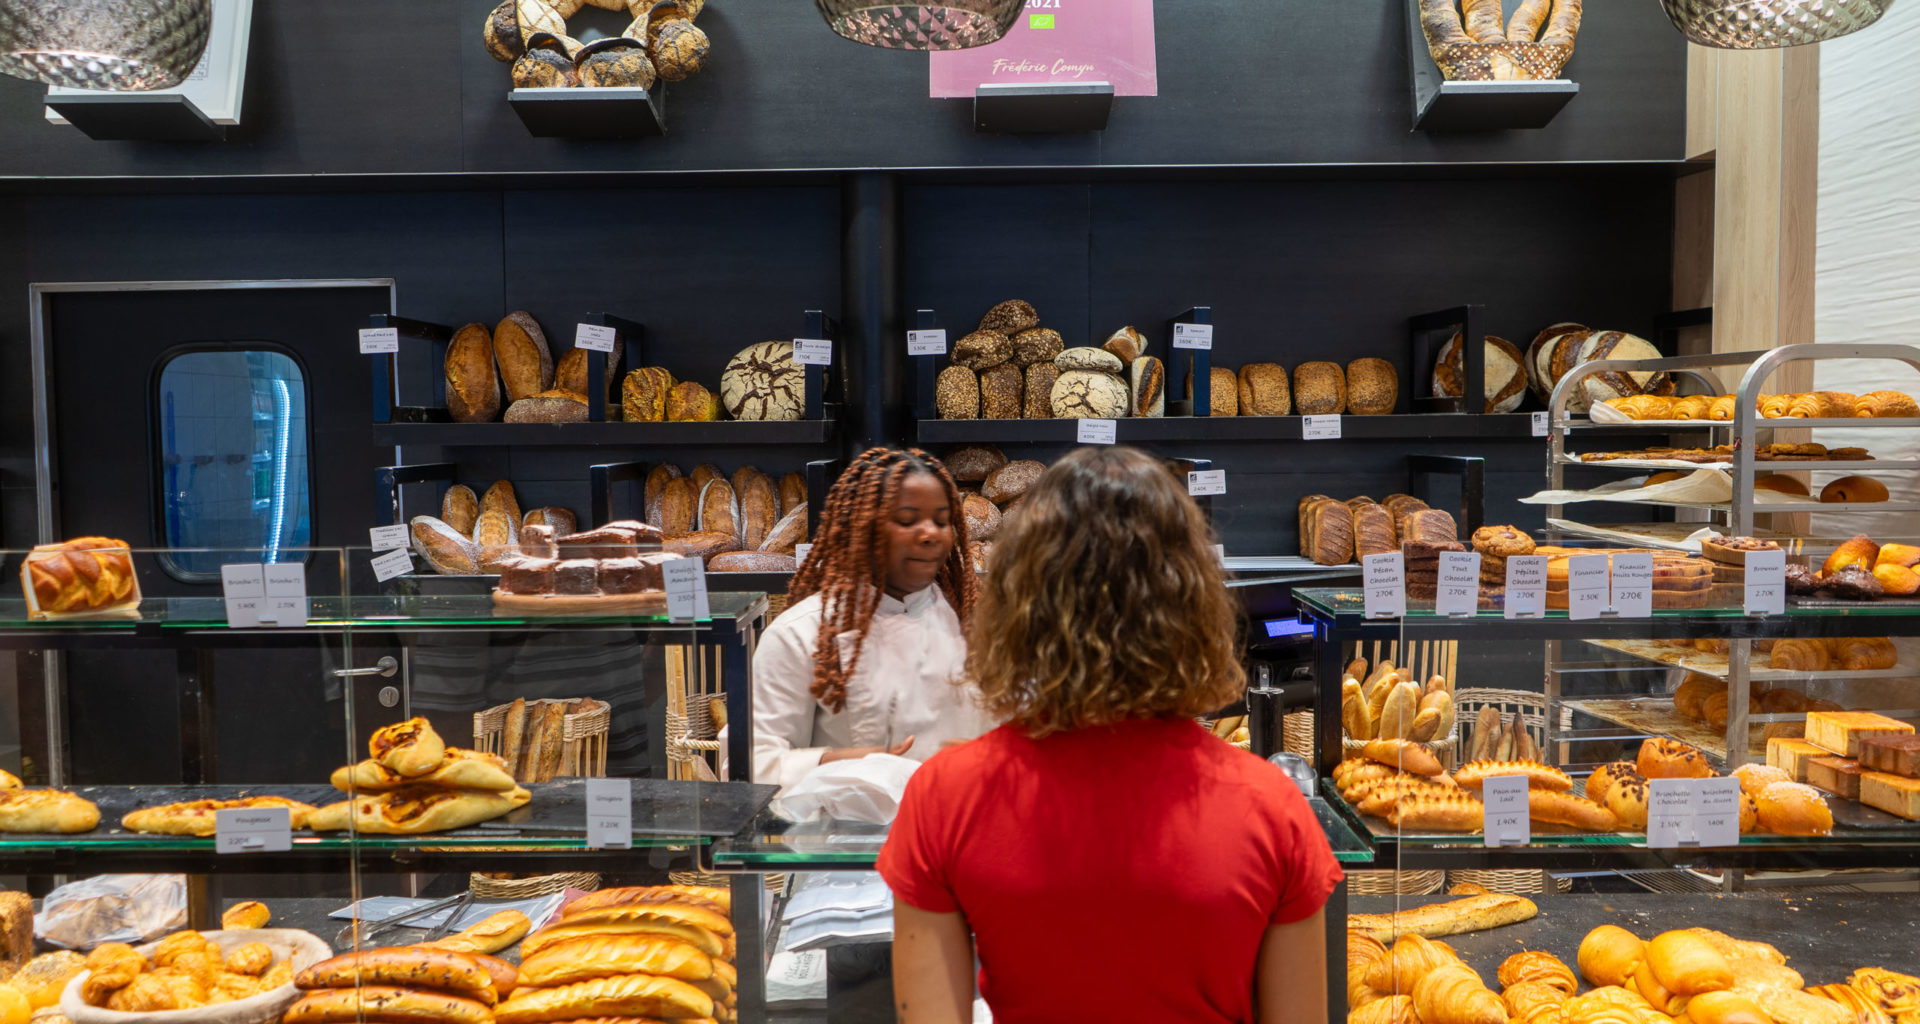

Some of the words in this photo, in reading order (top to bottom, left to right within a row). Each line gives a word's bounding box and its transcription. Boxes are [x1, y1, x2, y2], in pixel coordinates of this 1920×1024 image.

[992, 58, 1048, 76] Frédéric
[1050, 58, 1095, 79] Comyn
[1371, 557, 1395, 565] Cookie
[1449, 555, 1472, 563] Cookie
[1370, 576, 1399, 584] Chocolat
